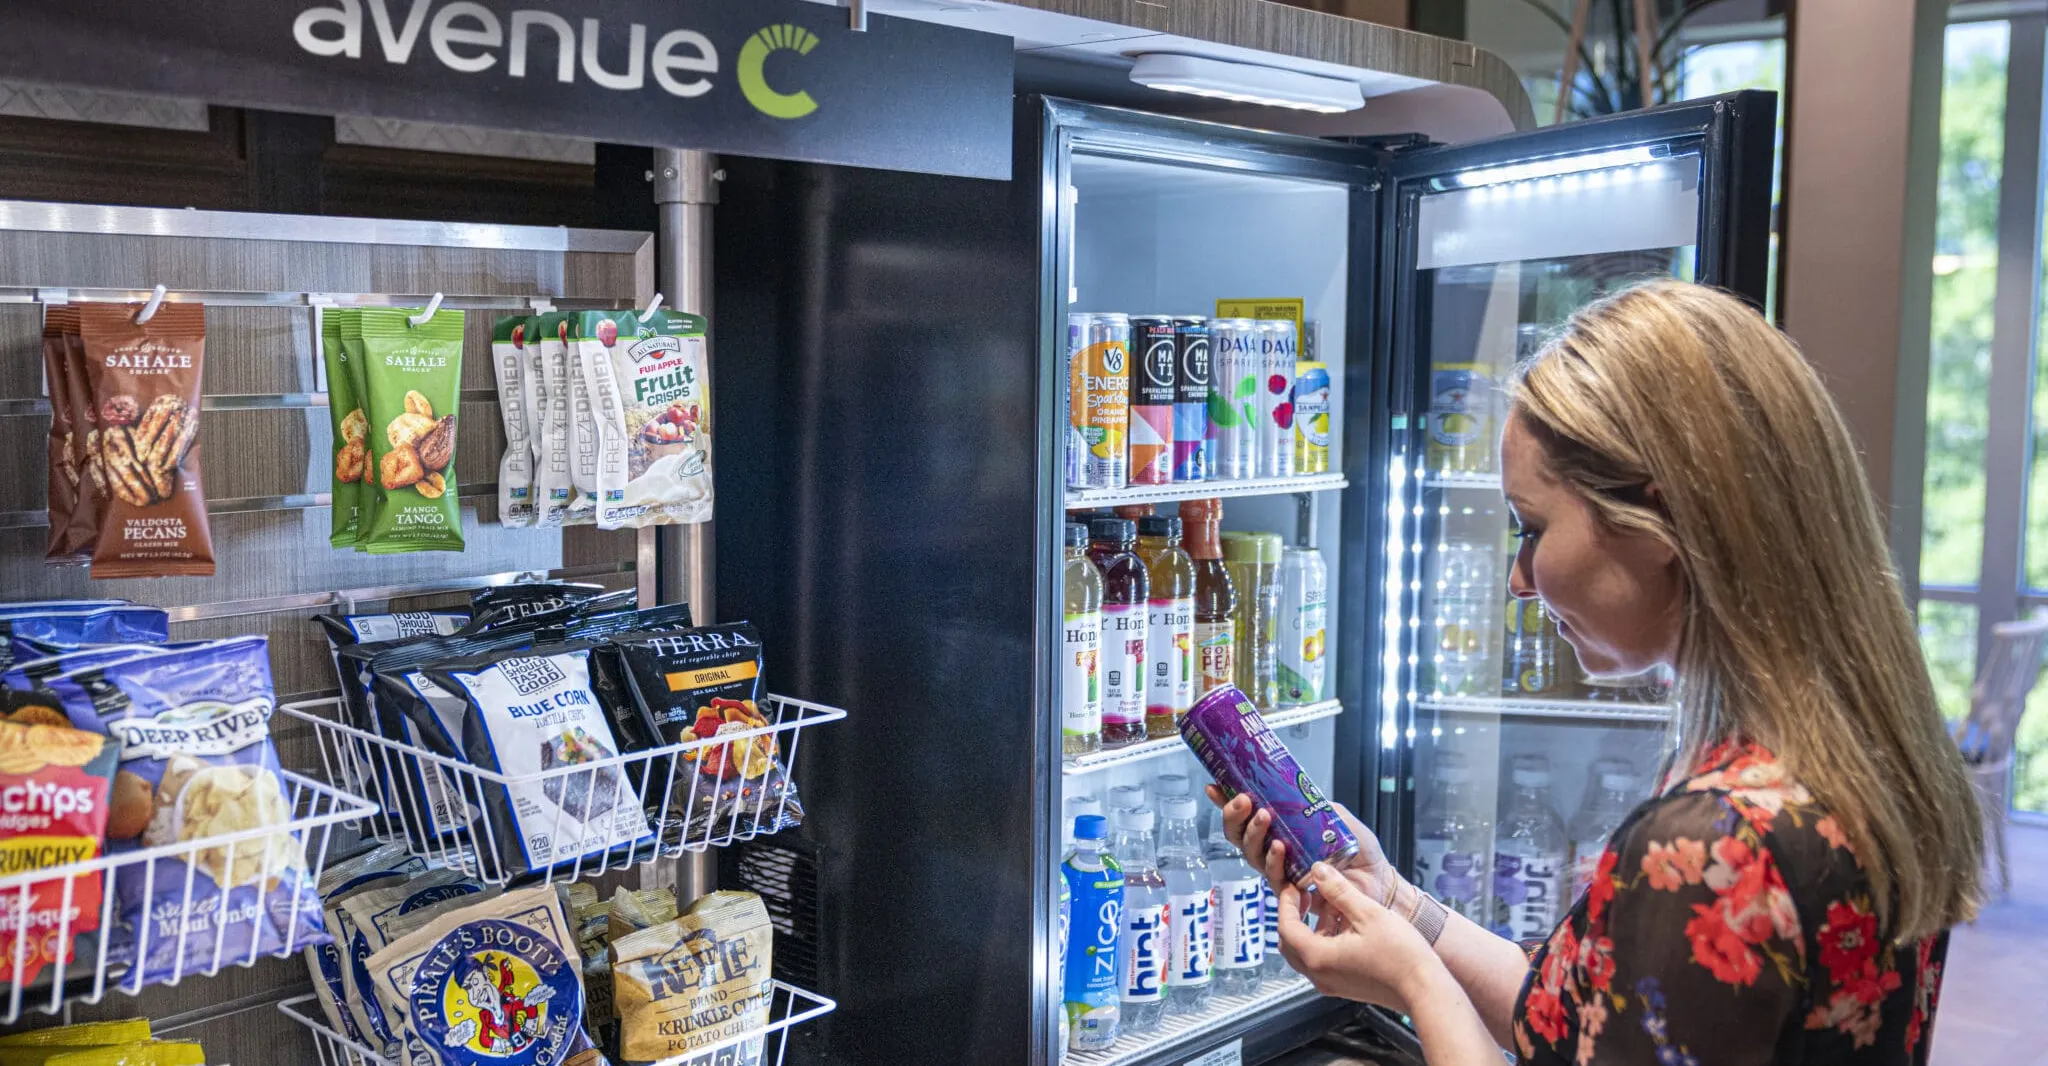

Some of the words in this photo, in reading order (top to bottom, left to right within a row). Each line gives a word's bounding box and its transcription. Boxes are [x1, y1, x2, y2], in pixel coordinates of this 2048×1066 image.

[293, 0, 719, 97] avenue
[106, 355, 192, 368] SAHALE
[385, 356, 446, 367] SAHALE
[639, 364, 656, 374] FUJI
[657, 358, 683, 370] APPLE
[1104, 347, 1122, 371] V8
[1158, 350, 1173, 362] MA
[635, 365, 694, 401] Fruit
[647, 386, 690, 407] CRISPS
[503, 355, 523, 472] FREEZEDRIED
[551, 353, 567, 473] FREEZEDRIED
[592, 353, 620, 474] FREEZEDRIED
[126, 518, 182, 527] VALDOSTA
[396, 513, 444, 524] TANGO
[124, 526, 187, 540] PECANS
[399, 619, 434, 629] SHOULD
[1116, 617, 1144, 631] Hon
[1165, 613, 1189, 626] Hon
[401, 628, 436, 639] TASTE
[1066, 629, 1096, 643] Hon
[648, 632, 752, 657] TERRA
[506, 658, 548, 678] SHOULD
[672, 656, 687, 665] real
[689, 653, 720, 663] vegetable
[722, 650, 741, 659] chips
[1203, 655, 1231, 671] PEA
[510, 664, 554, 685] TASTE
[518, 671, 560, 694] GOOD
[694, 670, 731, 684] ORIGINAL
[705, 687, 719, 695] SALT
[508, 699, 555, 719] BLUE
[554, 689, 590, 708] CORN
[121, 726, 190, 749] DEEP
[3, 779, 94, 820] chips
[532, 836, 549, 850] 220
[0, 845, 86, 872] RUNCHY
[1234, 884, 1259, 963] hint
[1096, 900, 1120, 976] zico
[1182, 898, 1208, 979] hint
[1129, 914, 1160, 997] hint
[419, 930, 476, 1022] PIRATE'S
[482, 927, 559, 974] BOOTY
[690, 989, 728, 1009] BRAND
[658, 1004, 732, 1035] KRINKLE
[732, 995, 760, 1017] CUT
[668, 1030, 720, 1051] POTATO
[723, 1016, 757, 1036] CHIPS
